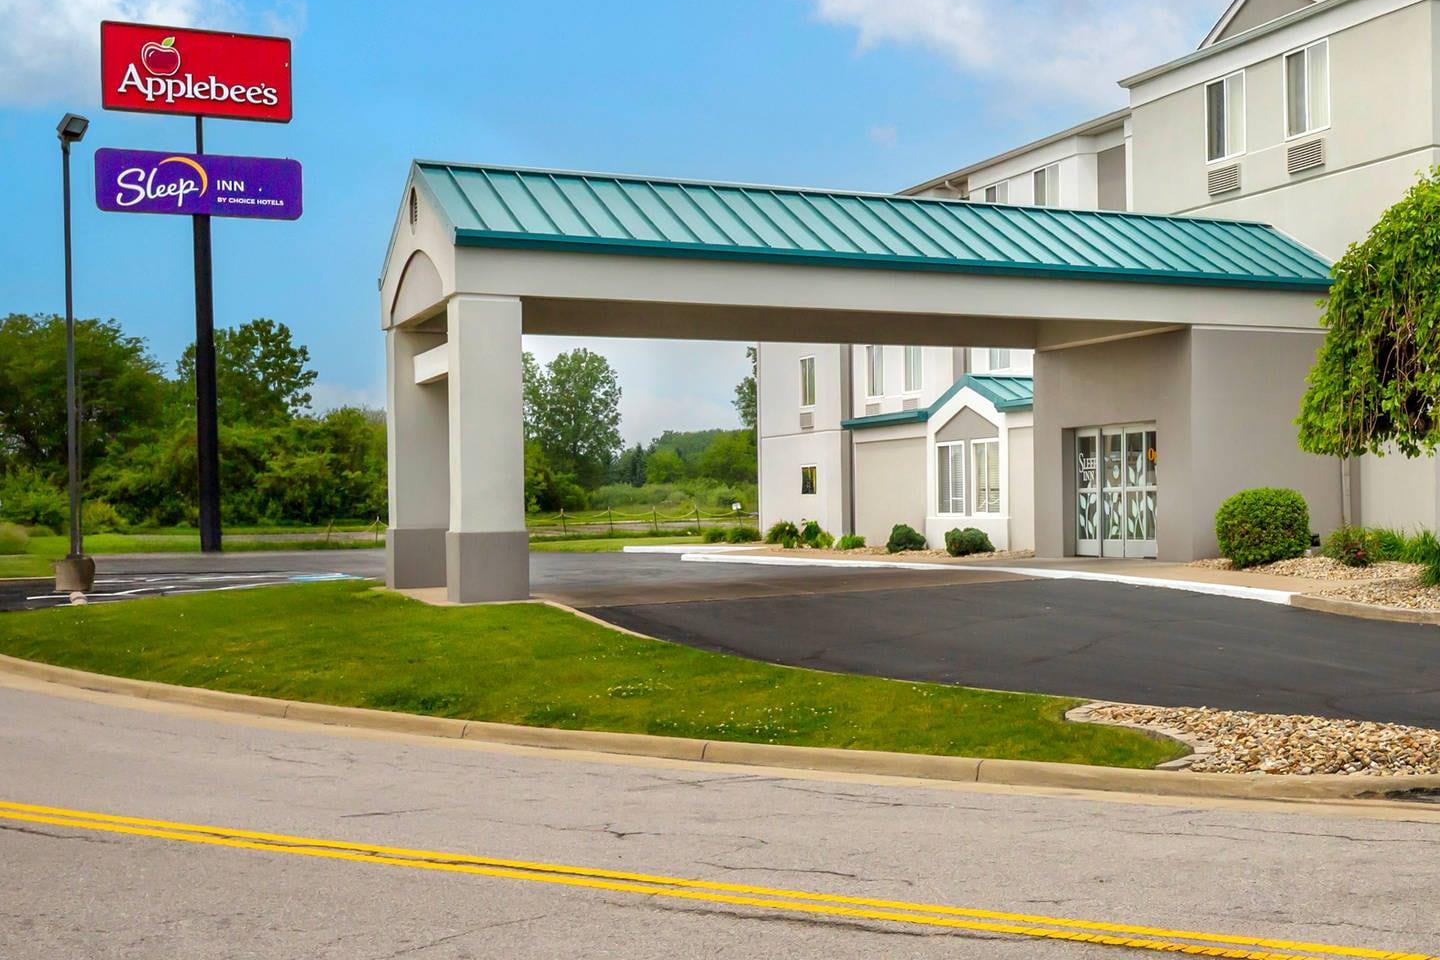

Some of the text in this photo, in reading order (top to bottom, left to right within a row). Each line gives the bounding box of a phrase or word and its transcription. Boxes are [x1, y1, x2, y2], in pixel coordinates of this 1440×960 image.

[117, 62, 278, 106] Applebee's
[116, 167, 245, 208] Sleep INN
[228, 197, 256, 205] CHOICE
